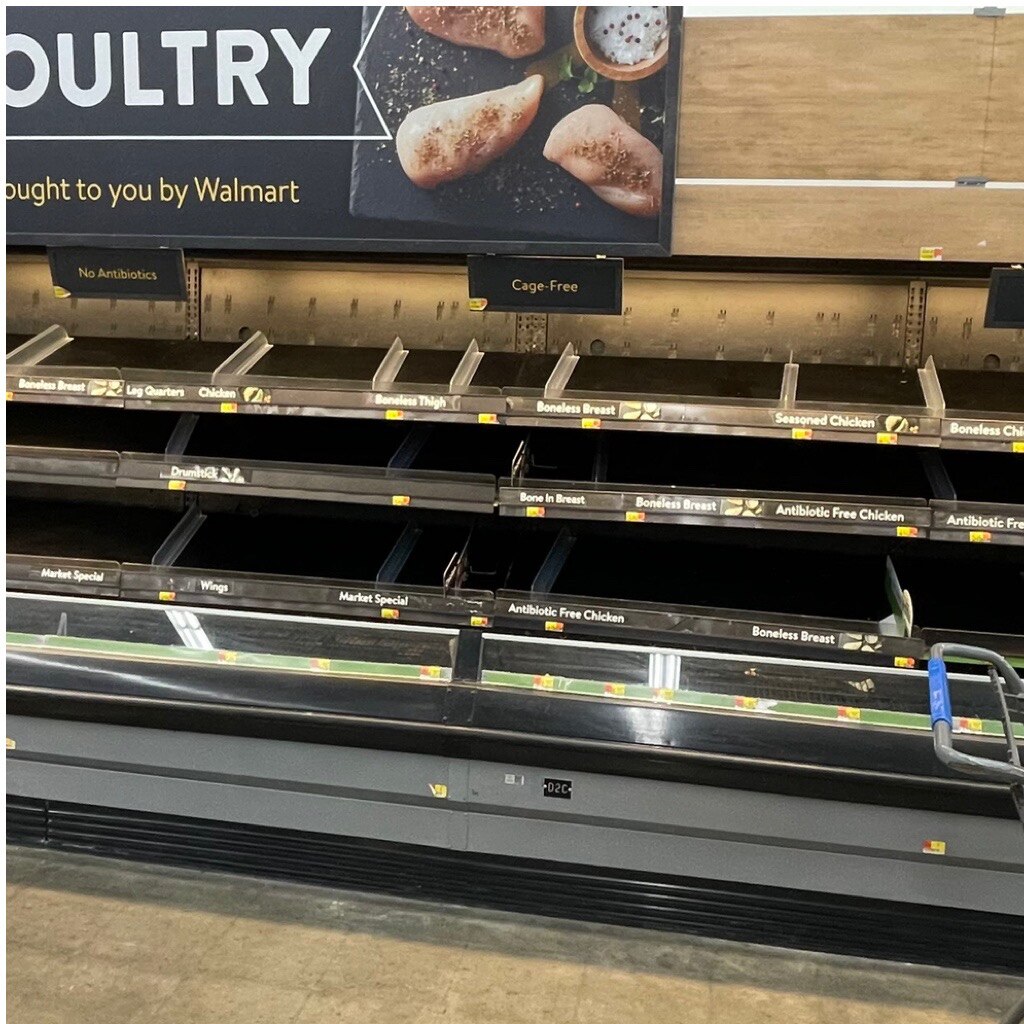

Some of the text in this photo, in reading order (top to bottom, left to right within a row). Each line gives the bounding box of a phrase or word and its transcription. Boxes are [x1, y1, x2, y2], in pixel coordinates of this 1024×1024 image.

[6, 28, 331, 107] OULTRY
[76, 178, 101, 202] to
[108, 182, 152, 208] you
[160, 177, 189, 209] by
[194, 176, 300, 203] Walmart
[78, 267, 158, 281] No Antibiotics
[511, 278, 579, 295] Cage-Free
[18, 378, 85, 392] Boneless Breast
[127, 385, 185, 398] Leg Quarters
[198, 387, 236, 399] Chicken
[375, 393, 446, 409] Boneless Thigh
[536, 400, 616, 416] Boneless Breast
[775, 412, 875, 428] Seasoned Chicken
[950, 422, 1001, 436] Boneless
[520, 492, 585, 505] Bone In Breast
[635, 496, 717, 511] Boneless Breast
[776, 504, 904, 522] Antibiotic Free Chicken
[946, 514, 1004, 528] Antibiotic
[41, 568, 104, 582] Market Special
[200, 580, 228, 593] Wings
[339, 592, 408, 606] Market Special
[508, 603, 625, 623] Antibiotic Free Chicken
[752, 625, 835, 644] Boneless Breast
